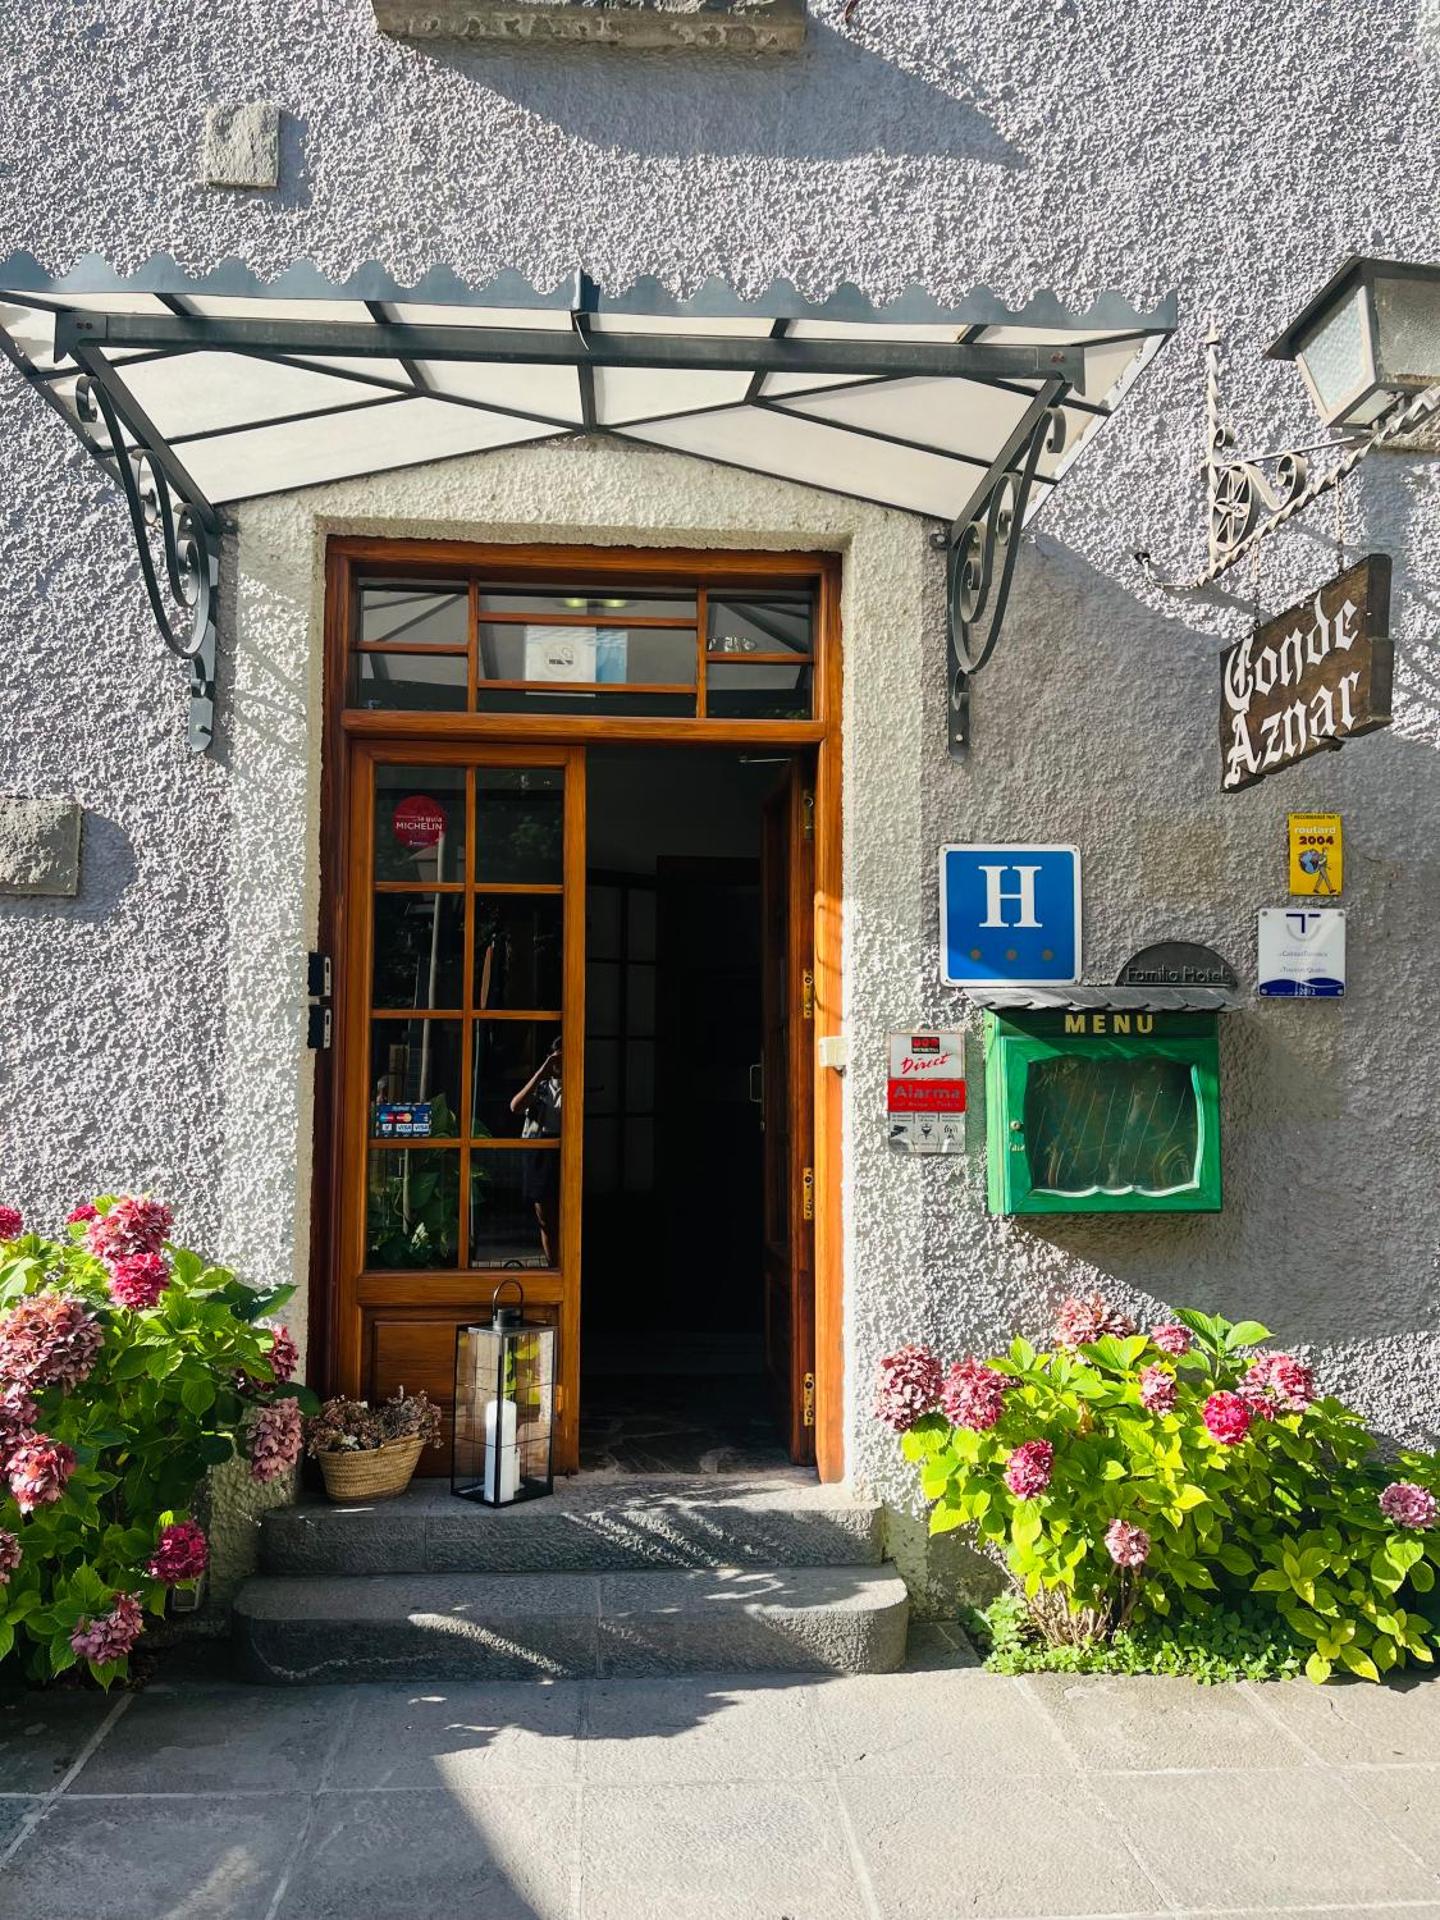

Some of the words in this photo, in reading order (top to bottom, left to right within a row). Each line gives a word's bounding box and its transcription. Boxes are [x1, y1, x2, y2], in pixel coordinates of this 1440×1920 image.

[1224, 589, 1359, 713] Conde
[1223, 671, 1361, 789] Aznar
[396, 822, 442, 830] MICHELIN
[1294, 826, 1336, 834] routard
[1298, 835, 1334, 846] 2004
[978, 865, 1043, 928] H
[1183, 964, 1231, 982] Hotels
[1064, 1014, 1154, 1034] MENU
[894, 1084, 961, 1099] Alarma
